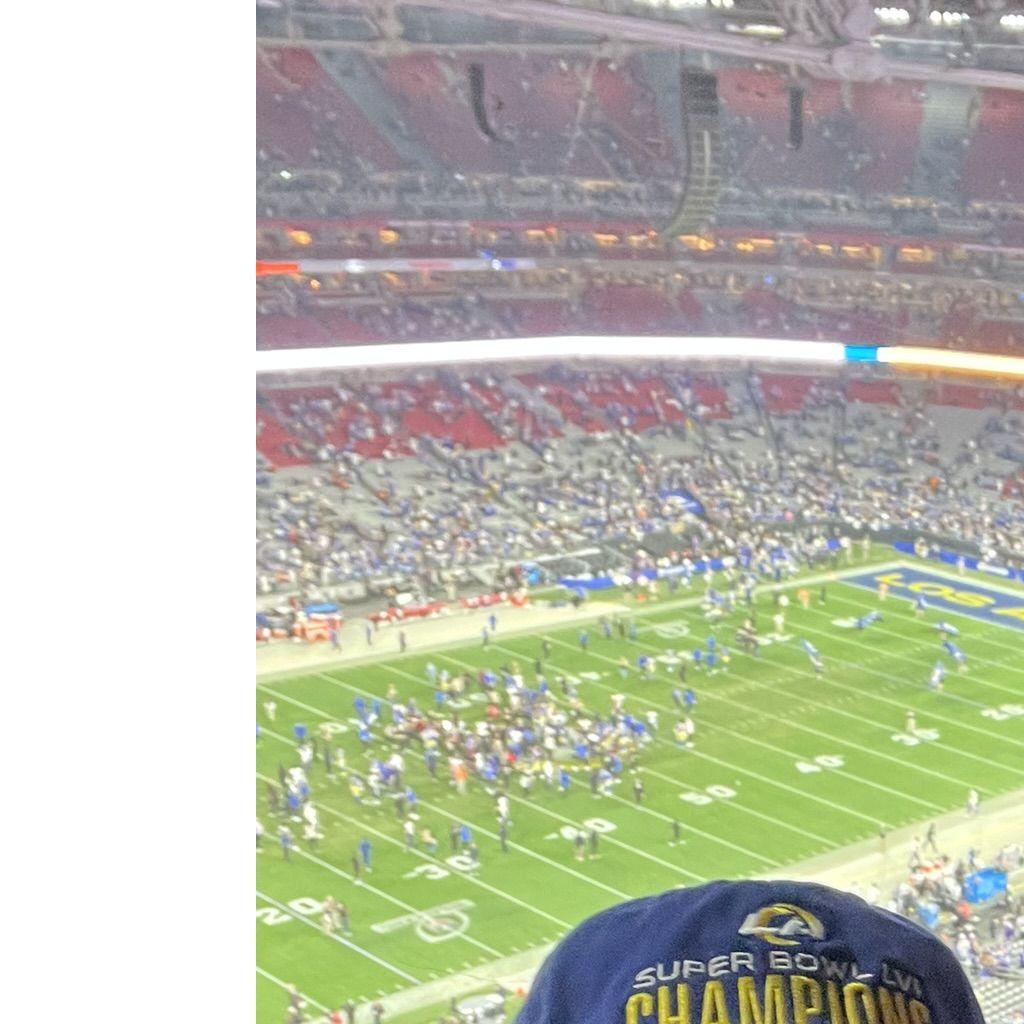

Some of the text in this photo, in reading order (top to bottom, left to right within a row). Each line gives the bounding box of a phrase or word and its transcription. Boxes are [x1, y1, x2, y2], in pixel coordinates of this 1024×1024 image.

[874, 573, 996, 608] LOS
[632, 950, 924, 1000] SUPER BOWL LVI
